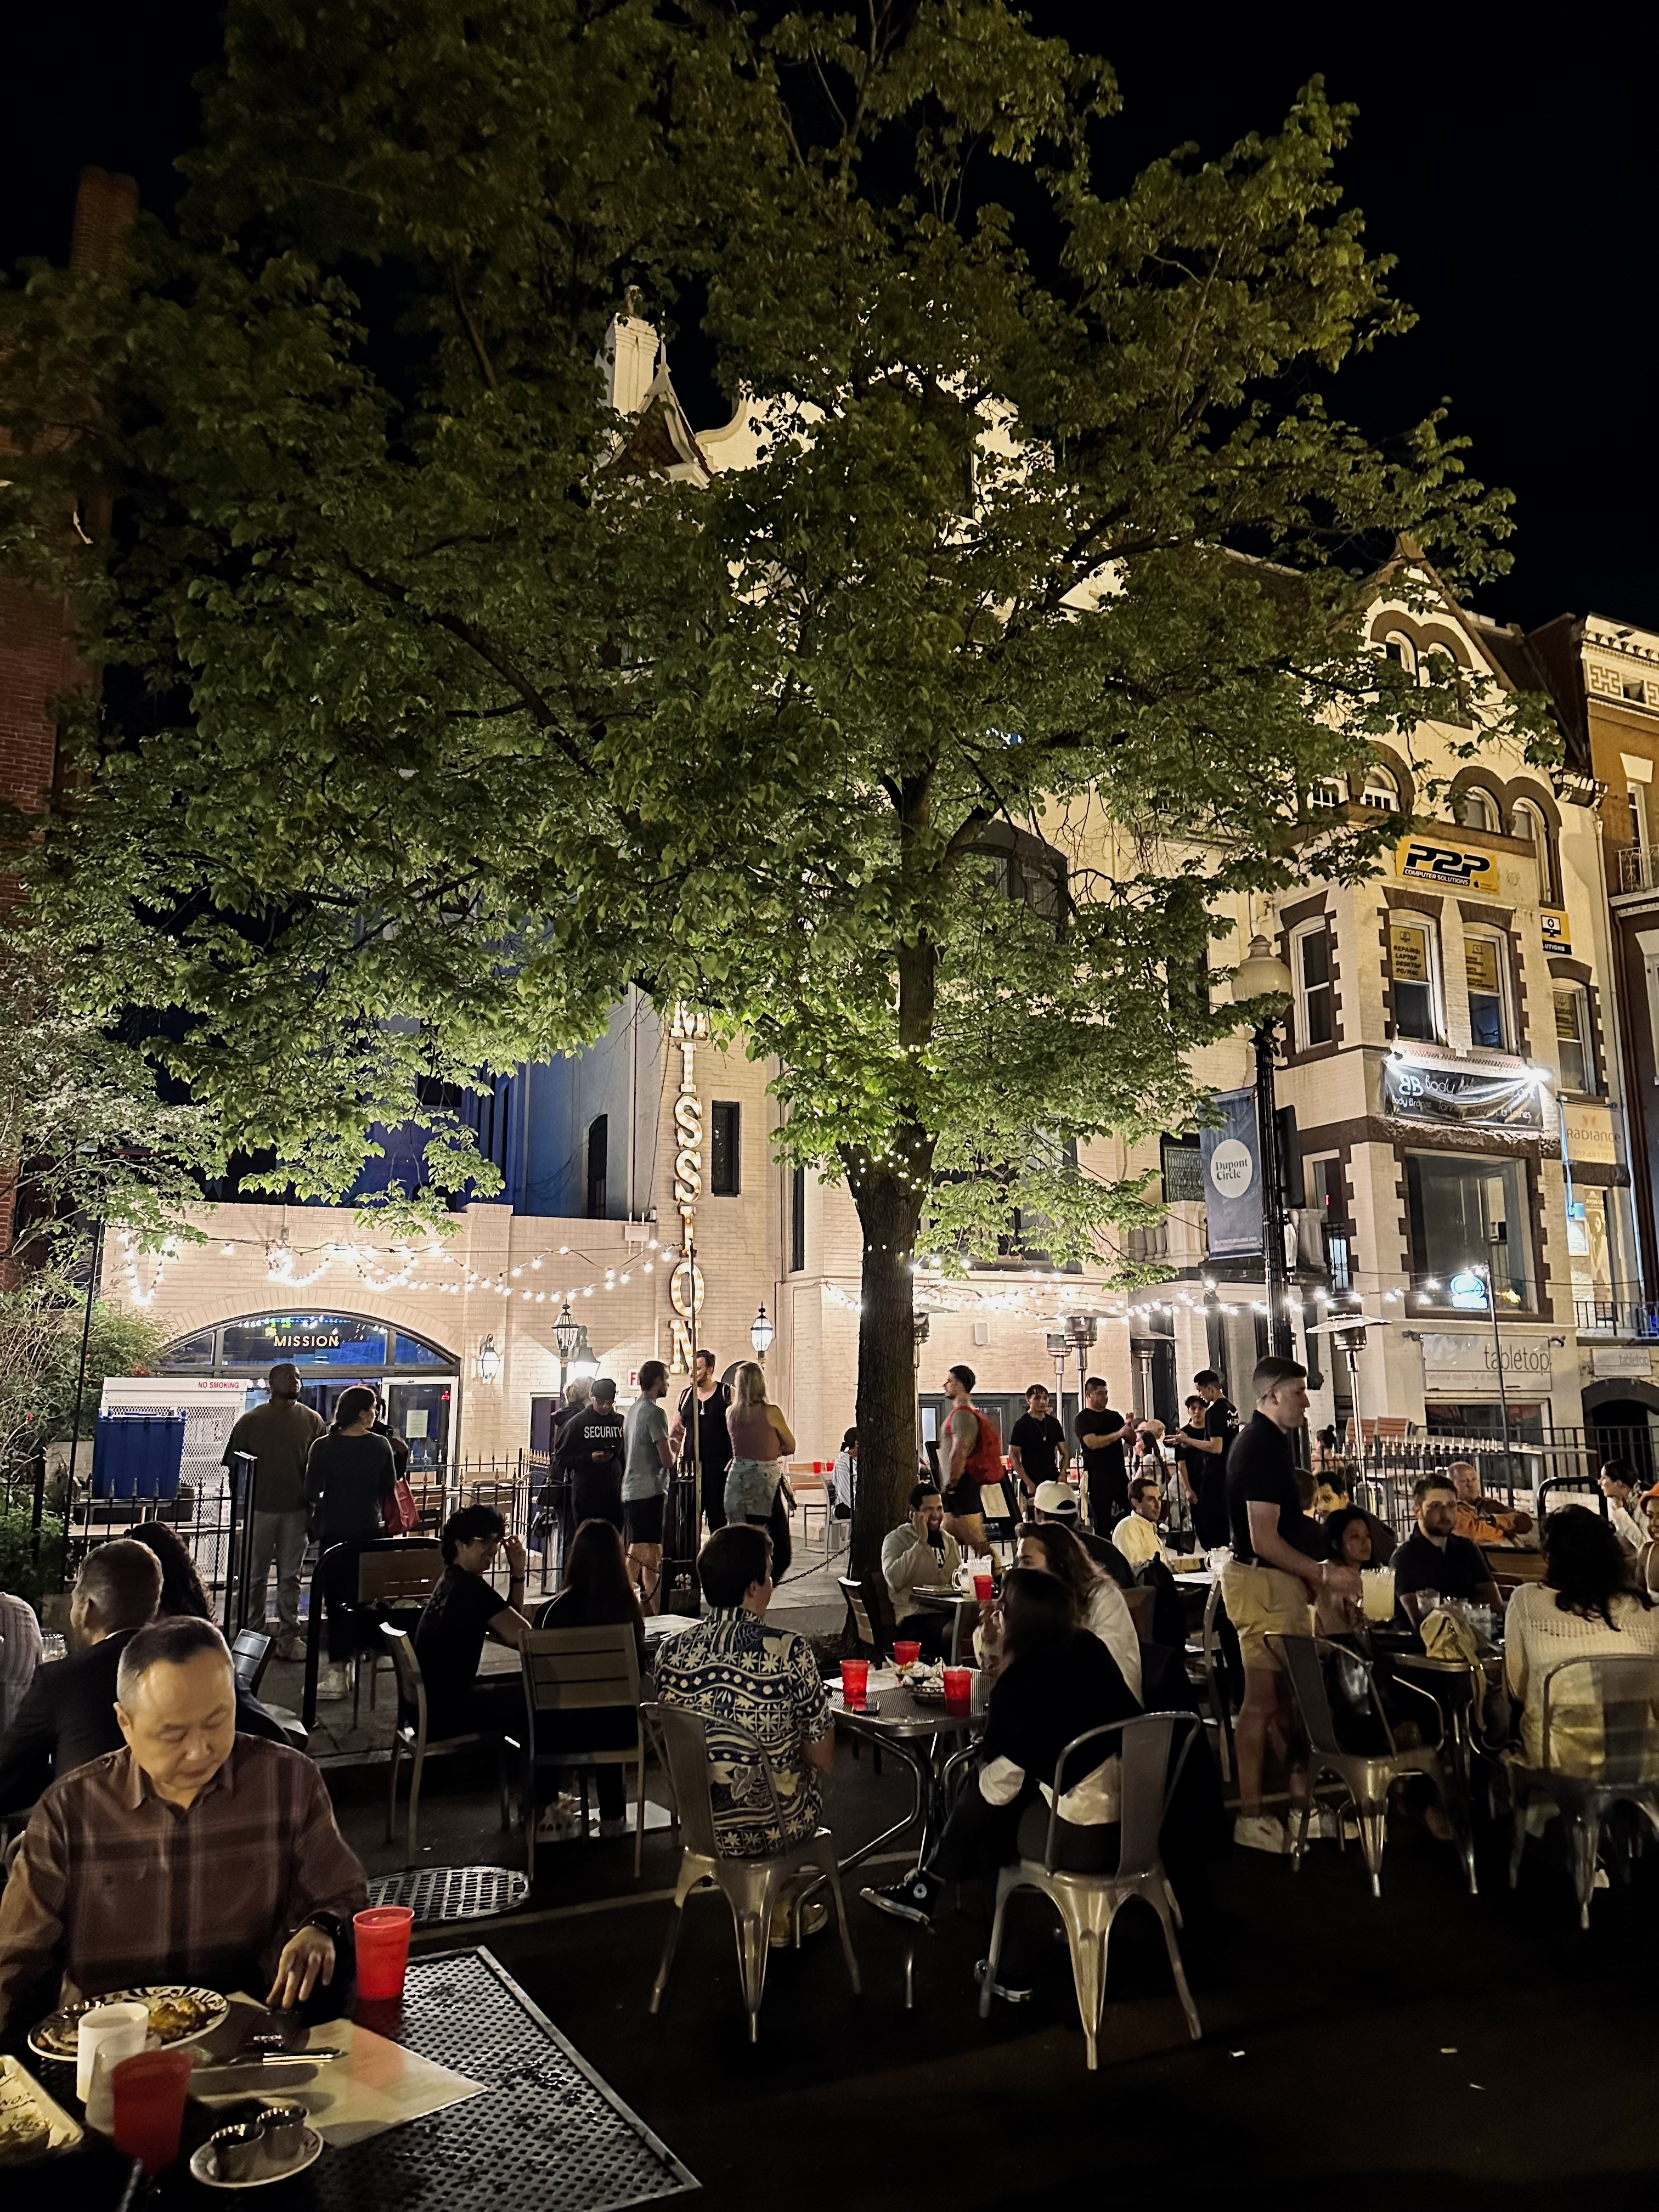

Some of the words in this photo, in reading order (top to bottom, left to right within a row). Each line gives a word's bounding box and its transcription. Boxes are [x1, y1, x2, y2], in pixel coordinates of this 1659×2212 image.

[1406, 843, 1490, 877] P2P
[1404, 868, 1436, 879] COMPUTER
[1437, 875, 1469, 885] SOLUTIONS
[1543, 943, 1565, 952] UTIONS
[1396, 961, 1421, 969] DESKTOP
[1425, 1074, 1455, 1097] Body
[1216, 1159, 1248, 1171] Dupont
[1217, 1169, 1241, 1181] Circle
[670, 998, 708, 1374] MISSION
[274, 1335, 339, 1347] MISSION
[1483, 1344, 1549, 1376] tabletop
[584, 1425, 623, 1439] SECURITY
